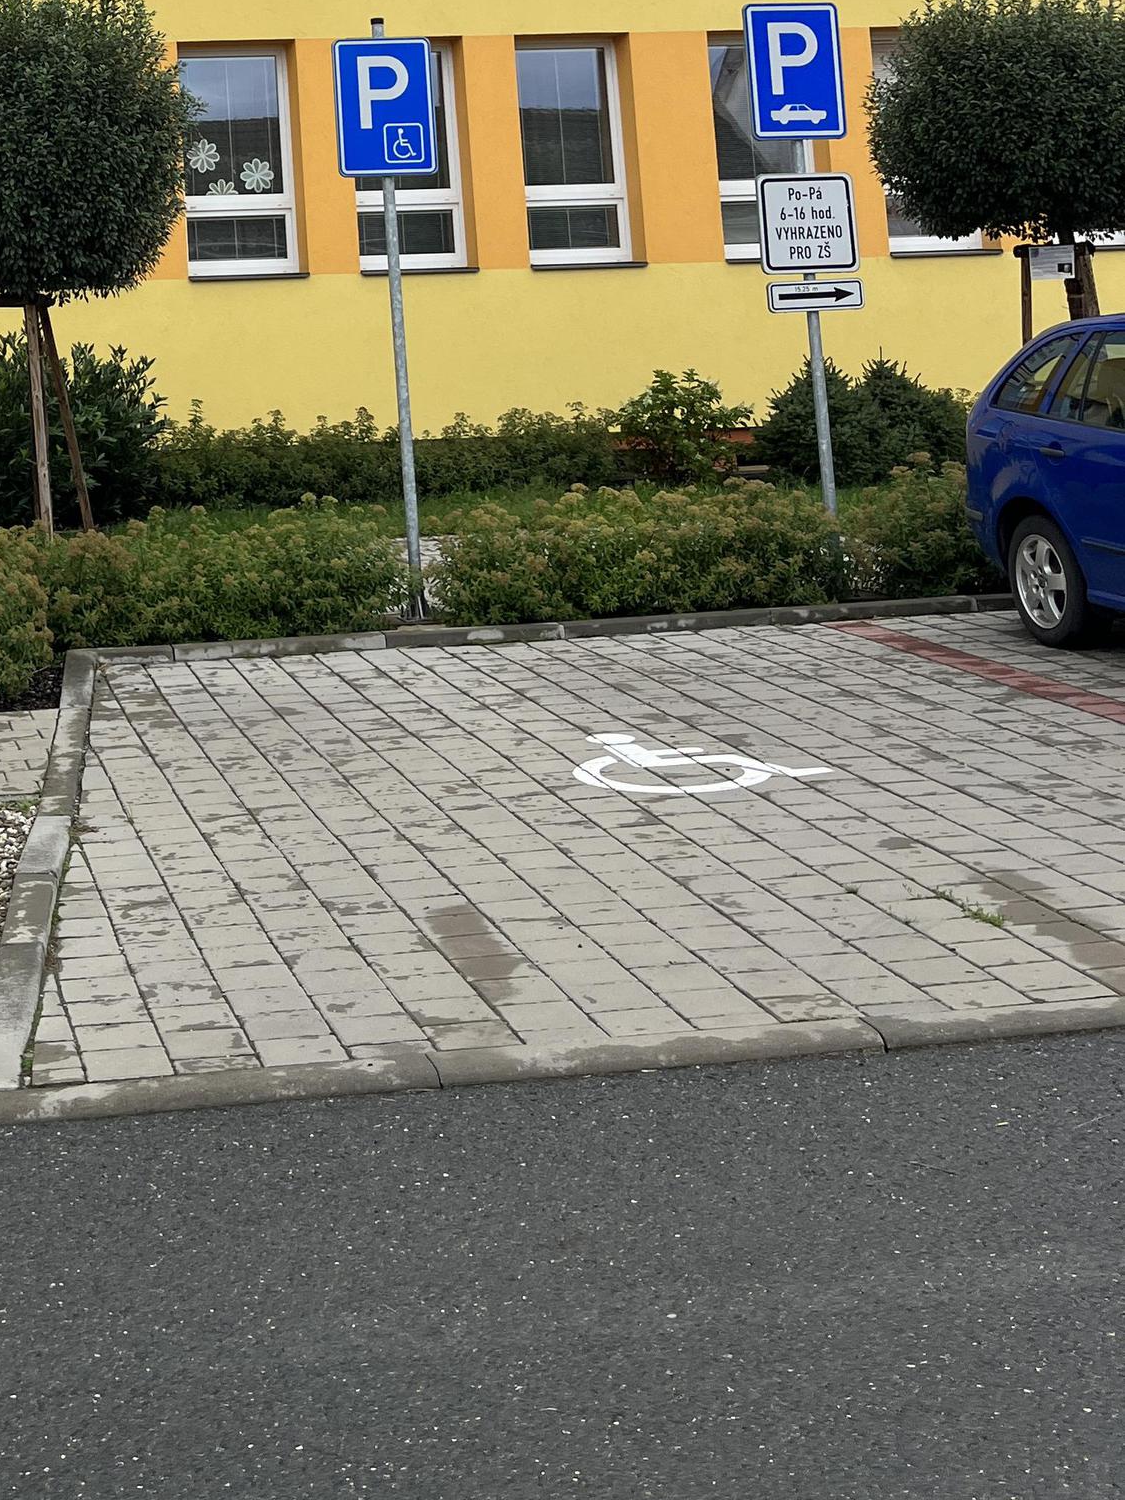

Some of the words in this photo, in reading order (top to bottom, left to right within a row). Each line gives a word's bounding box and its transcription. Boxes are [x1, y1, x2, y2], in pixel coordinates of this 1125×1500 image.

[767, 21, 818, 96] P
[356, 55, 409, 130] P
[788, 186, 823, 201] Po-Pá
[780, 206, 806, 221] 6-16
[811, 205, 836, 220] hod.
[775, 225, 843, 240] VYHRAZENO
[789, 246, 812, 260] PRO
[817, 241, 832, 259] ZŠ
